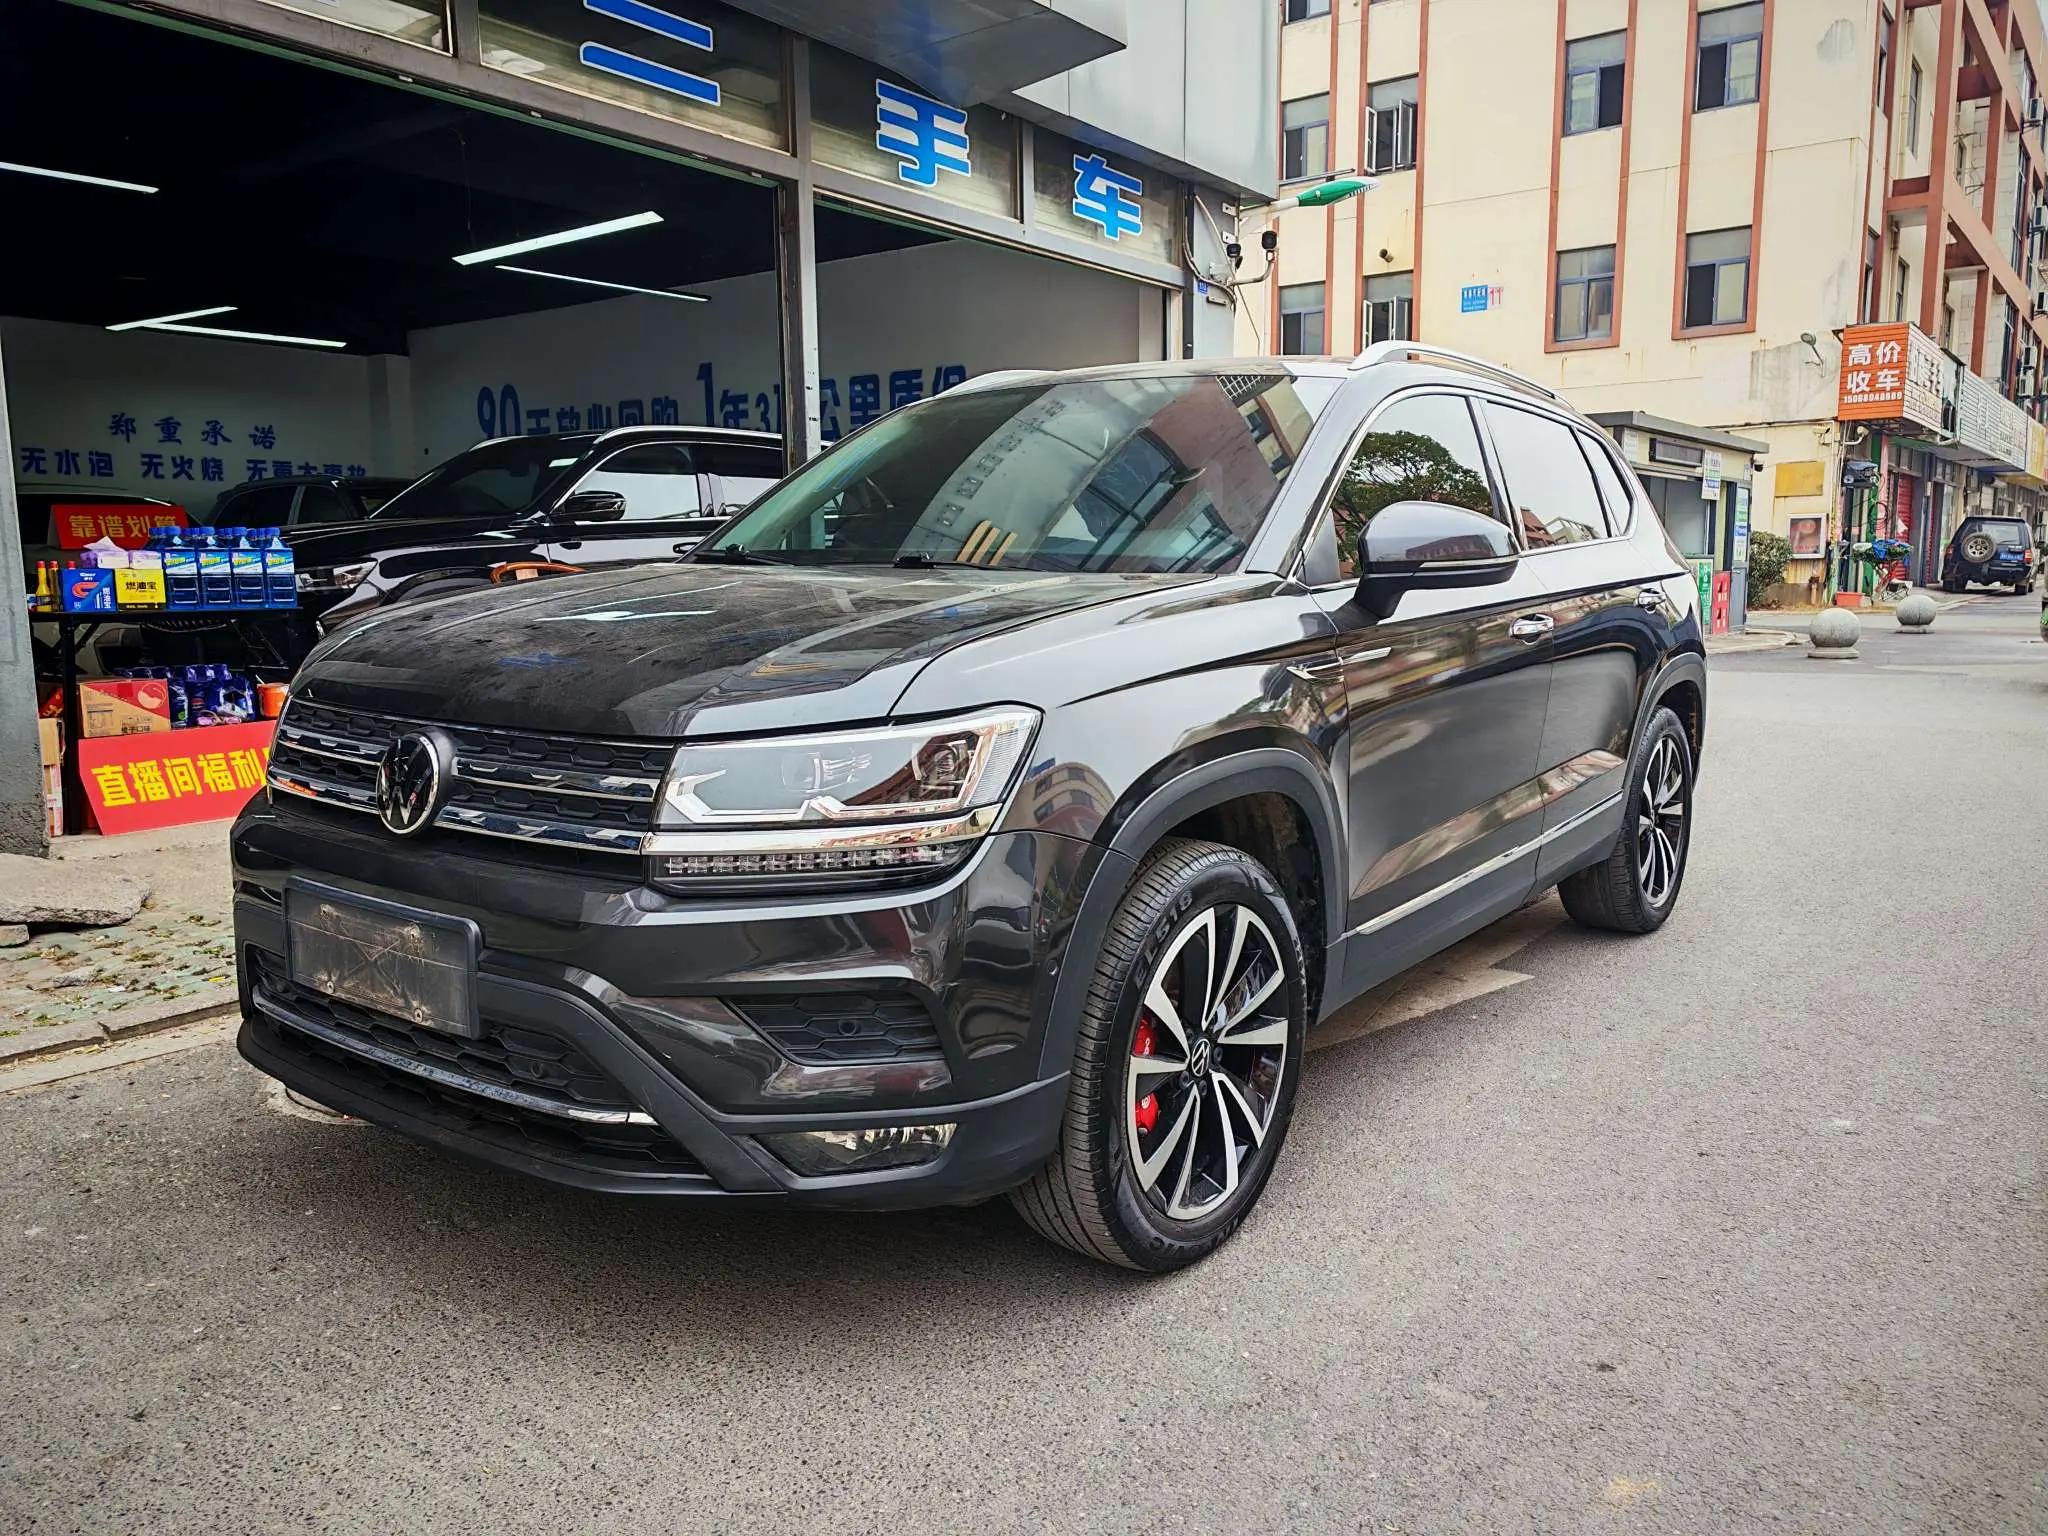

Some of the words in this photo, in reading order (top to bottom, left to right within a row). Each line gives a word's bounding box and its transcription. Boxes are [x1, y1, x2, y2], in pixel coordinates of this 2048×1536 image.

[1847, 340, 1902, 367] 高价
[1846, 368, 1901, 394] 收车
[108, 412, 277, 450] 郑重承诺
[20, 447, 115, 478] 无水泡
[140, 453, 225, 482] 无火烧
[91, 747, 270, 807] 直播间福利
